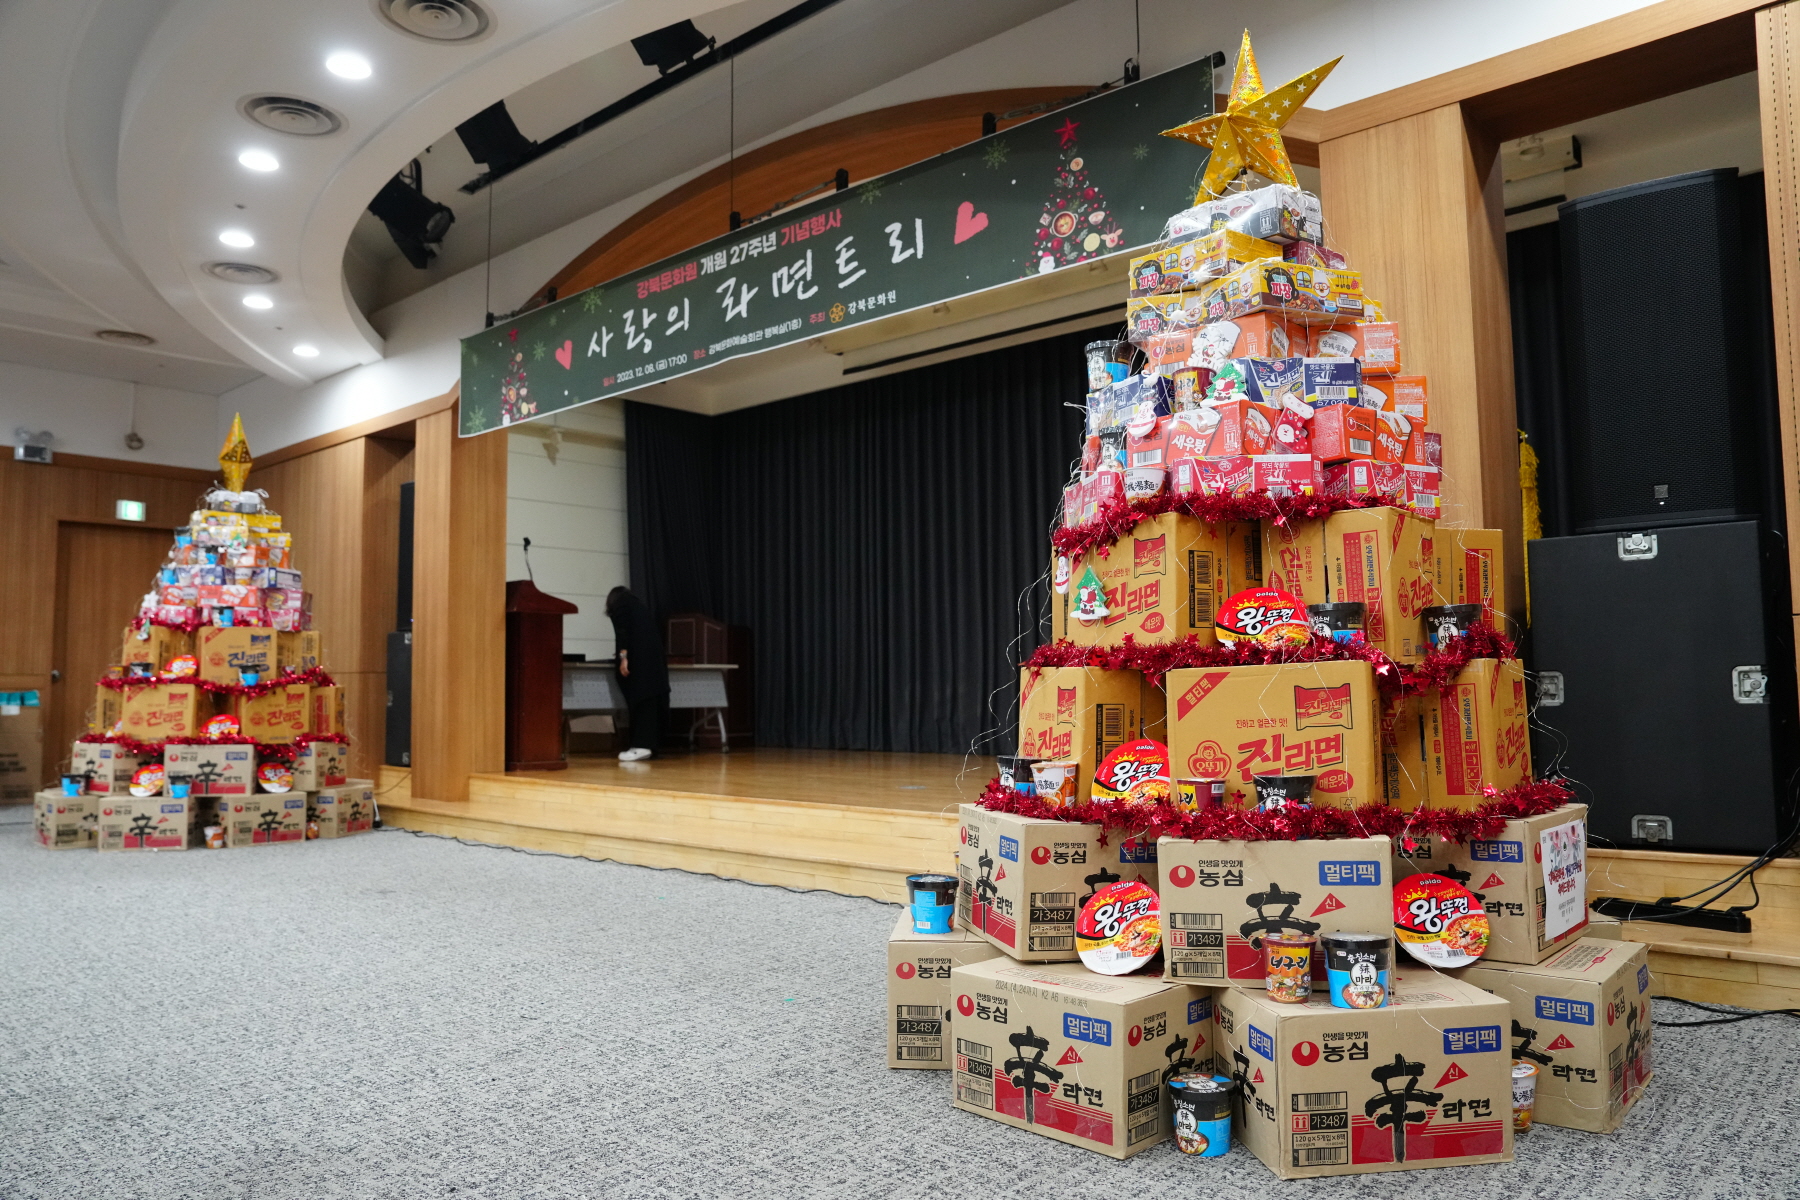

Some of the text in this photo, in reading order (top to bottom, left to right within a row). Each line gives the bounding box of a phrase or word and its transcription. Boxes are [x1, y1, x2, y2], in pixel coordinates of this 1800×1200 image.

[636, 208, 842, 299] 강북문화원 개원 27주년 기념행사
[847, 290, 897, 315] 강북문화원
[587, 299, 690, 358] 사랑의
[617, 370, 634, 383] 2023.
[635, 367, 644, 377] 12.
[645, 363, 655, 374] 08.
[656, 358, 668, 371] (금)
[668, 354, 688, 368] 17:00
[708, 331, 763, 355] 강북문화예술회관
[764, 318, 802, 339] 행복실(1층)
[809, 311, 826, 325] 주최
[1259, 367, 1302, 388] 진라면
[1172, 434, 1206, 453] 새우탕
[1247, 429, 1264, 448] 새우탕
[1377, 433, 1403, 457] 새우탕
[1203, 467, 1249, 491] 진라면
[1376, 473, 1403, 493] 진라면
[1279, 547, 1304, 598] 진라면
[1104, 579, 1160, 628] 진라면
[1410, 576, 1434, 618] 진라면
[1236, 606, 1295, 635] 왕뚜껑
[228, 651, 267, 668] 진라면
[1185, 678, 1211, 706] 멀티팩
[1304, 700, 1343, 714] 진라면
[1236, 717, 1288, 729] 진하고 얼큰한 맛!
[1381, 712, 1398, 747] 라면
[1037, 727, 1072, 759] 진라면
[1505, 721, 1525, 768] 진라면
[1196, 760, 1224, 774] 오뚜기
[1237, 733, 1343, 785] 진라면
[195, 760, 224, 794] 辛
[1110, 761, 1163, 792] 왕뚜껑
[1319, 775, 1346, 789] 매운맛
[1262, 787, 1287, 797] 충칭소면
[129, 813, 158, 848] 辛
[258, 809, 284, 842] 辛
[968, 831, 979, 848] 농심
[1001, 838, 1017, 859] 멀티팩
[1053, 849, 1087, 865] 농심
[1474, 844, 1520, 861] 멀티팩
[1198, 859, 1244, 868] 인생을 맛있게
[1324, 863, 1375, 883] 멀티팩
[1111, 881, 1135, 891] paldo
[1198, 869, 1244, 887] 농심
[1420, 878, 1442, 886] paldo
[1489, 876, 1498, 885] 신
[975, 849, 1013, 934] 辛 라면
[1325, 897, 1336, 910] 신
[1485, 901, 1525, 917] 라면
[1033, 910, 1072, 921] 가3487
[1094, 897, 1152, 938] 왕뚜껑
[1409, 897, 1469, 933] 왕뚜껑
[1188, 934, 1221, 946] 가3487
[1270, 955, 1308, 971] 너구리
[1347, 952, 1377, 964] 충칭소면
[918, 965, 951, 979] 농심
[1355, 976, 1373, 985] 마라
[976, 993, 1008, 1006] 인생을 맛있게
[1041, 990, 1048, 1000] K2
[1051, 992, 1058, 1002] A6
[976, 1001, 1008, 1024] 농심
[1144, 1011, 1166, 1024] 인생을 맛있게
[1541, 1000, 1588, 1021] 멀티팩
[1614, 996, 1626, 1020] 농심
[900, 1022, 939, 1032] 가3487
[1068, 1017, 1107, 1042] 멀티팩
[1144, 1019, 1166, 1041] 농심
[1221, 1012, 1233, 1034] 농심
[1250, 1029, 1271, 1057] 멀티팩
[1322, 1031, 1369, 1041] 인생을 맛있게
[1448, 1029, 1497, 1050] 멀티팩
[1558, 1038, 1566, 1046] 신
[1067, 1052, 1077, 1062] 신
[1322, 1041, 1369, 1063] 농심
[969, 1061, 991, 1076] 가3487
[1004, 1025, 1104, 1125] 辛 라면
[1448, 1067, 1459, 1080] 신
[1552, 1065, 1597, 1083] 라면
[1130, 1091, 1157, 1109] 가3487
[1256, 1097, 1275, 1122] 라면
[1364, 1053, 1492, 1163] 辛 라면
[1179, 1121, 1192, 1131] 마라
[1311, 1115, 1346, 1128] 가3487
